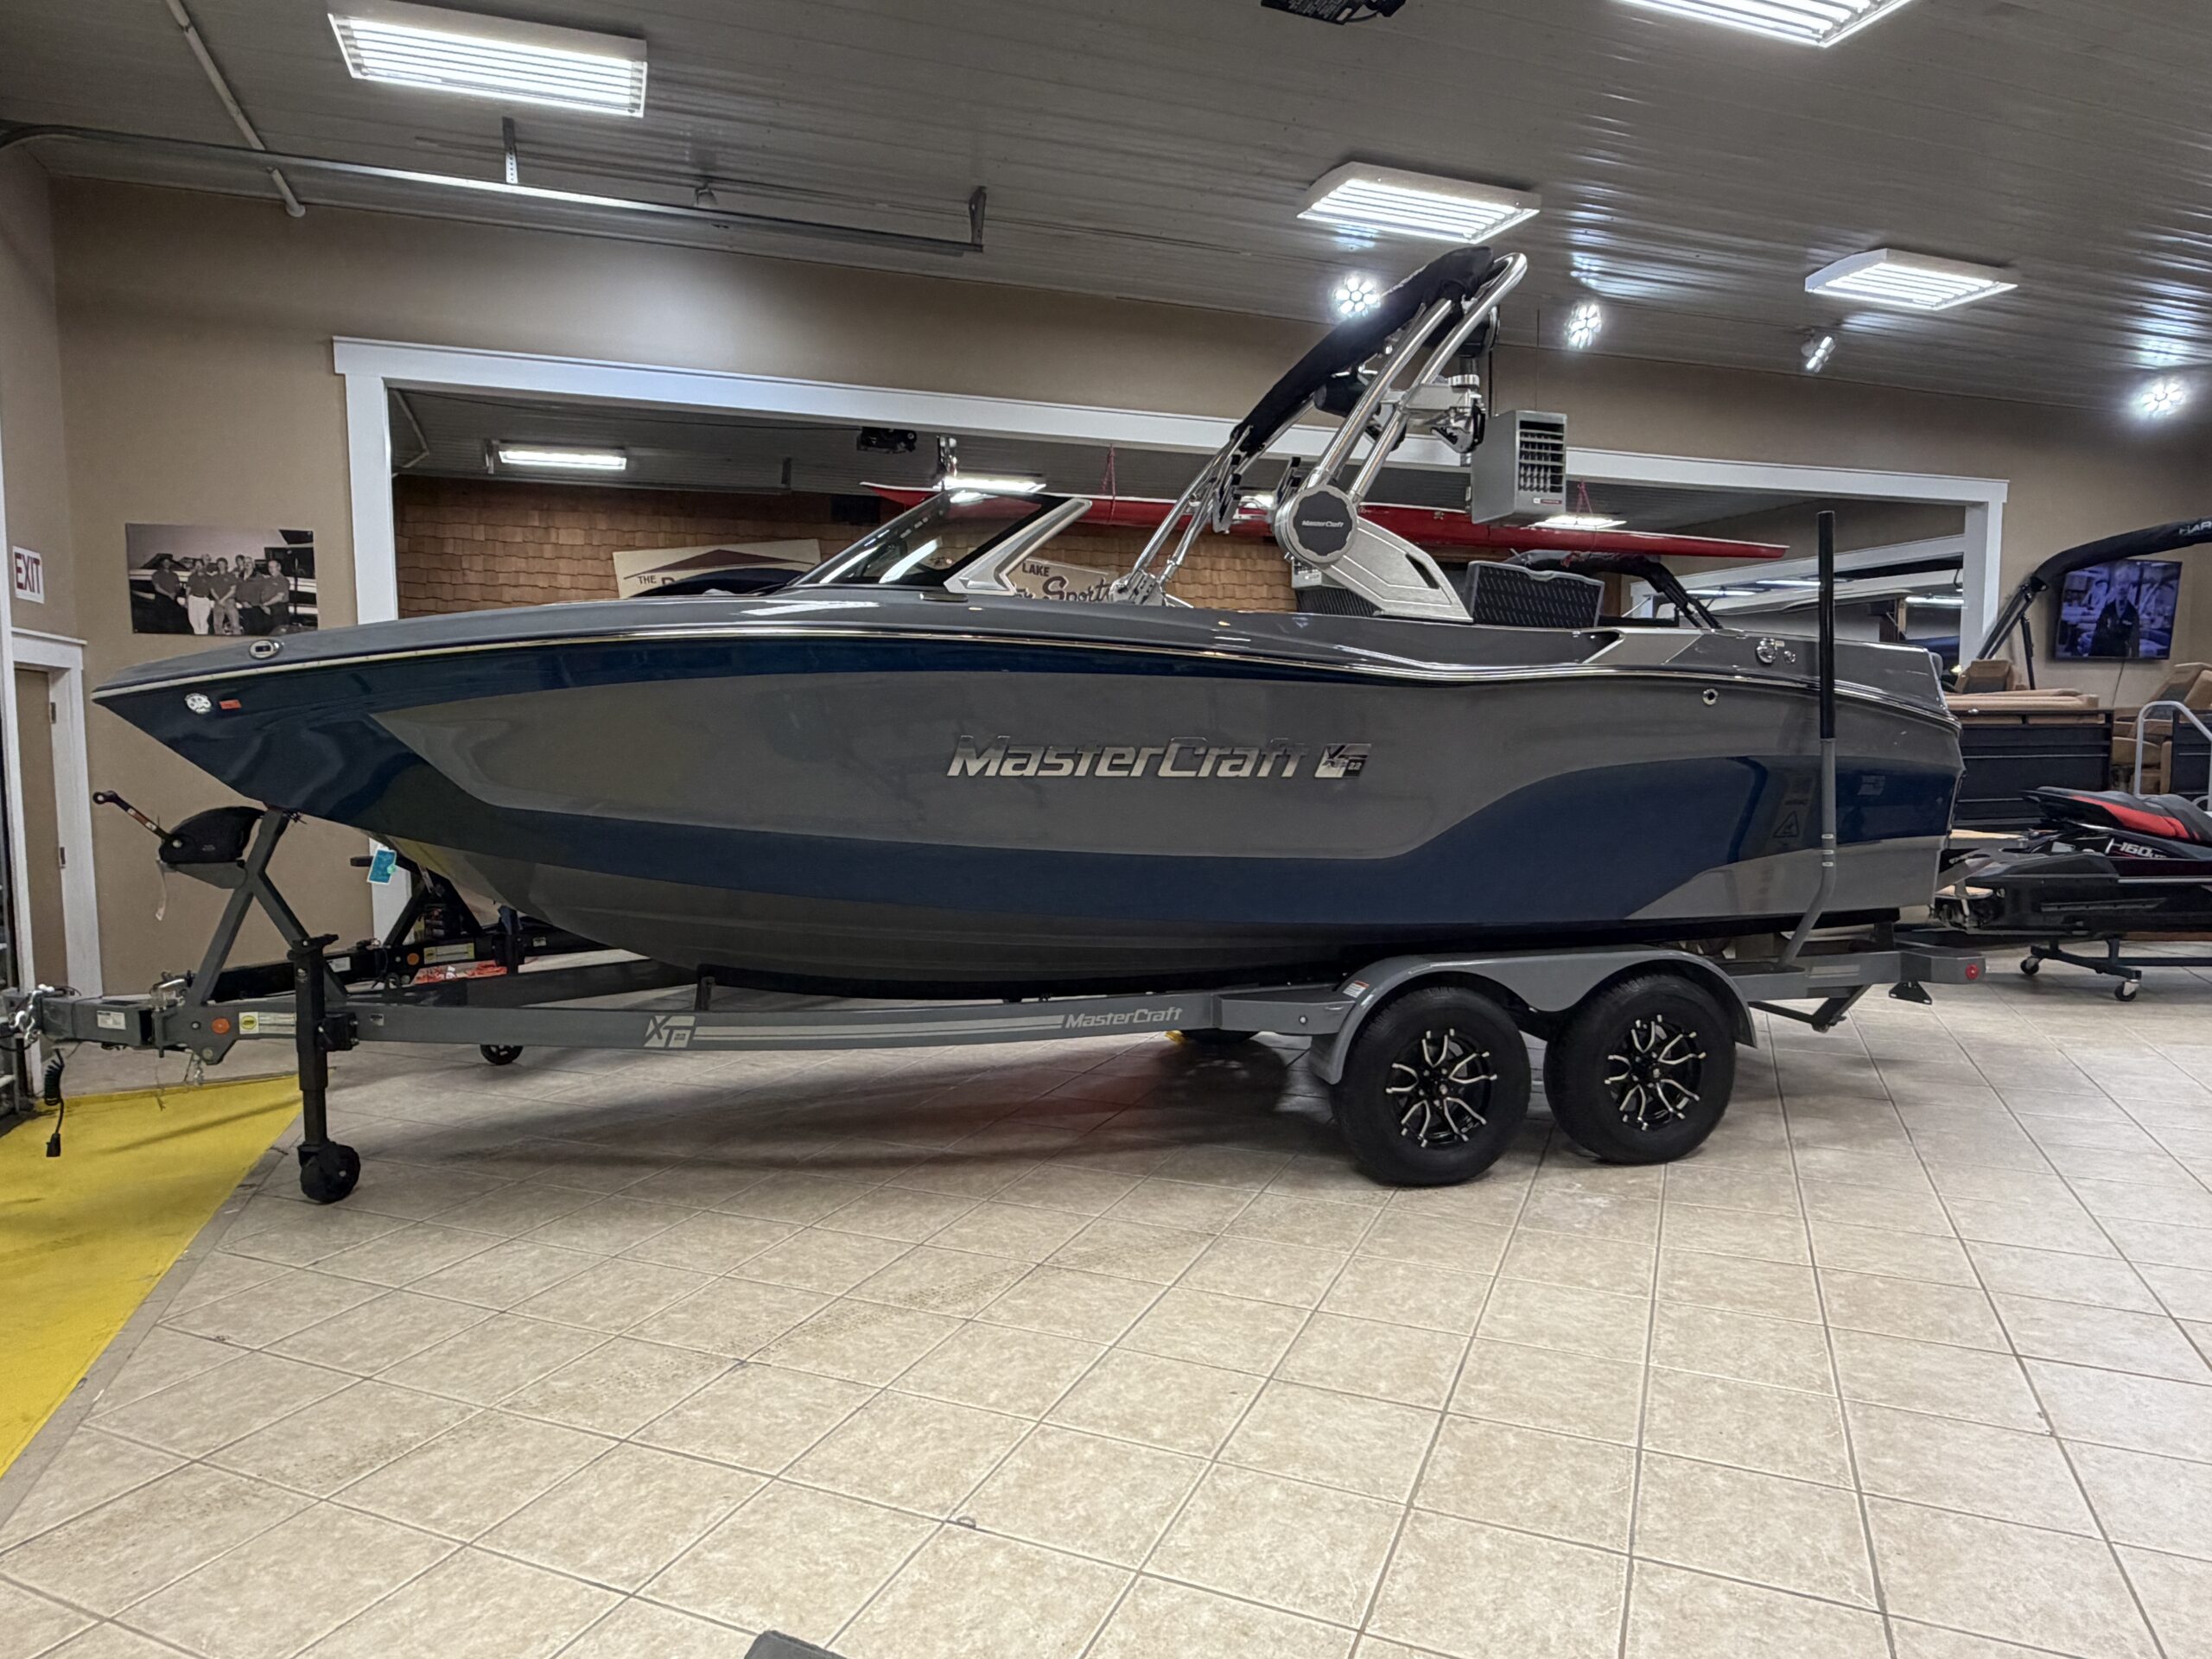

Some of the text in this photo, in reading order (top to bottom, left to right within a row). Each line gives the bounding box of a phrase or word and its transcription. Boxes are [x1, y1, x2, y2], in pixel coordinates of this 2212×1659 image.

[14, 552, 41, 594] EXIT
[638, 575, 657, 585] THE
[1022, 563, 1051, 577] LAKE
[947, 735, 1310, 777] MasterCraft
[1065, 1007, 1183, 1029] MasterCraft
